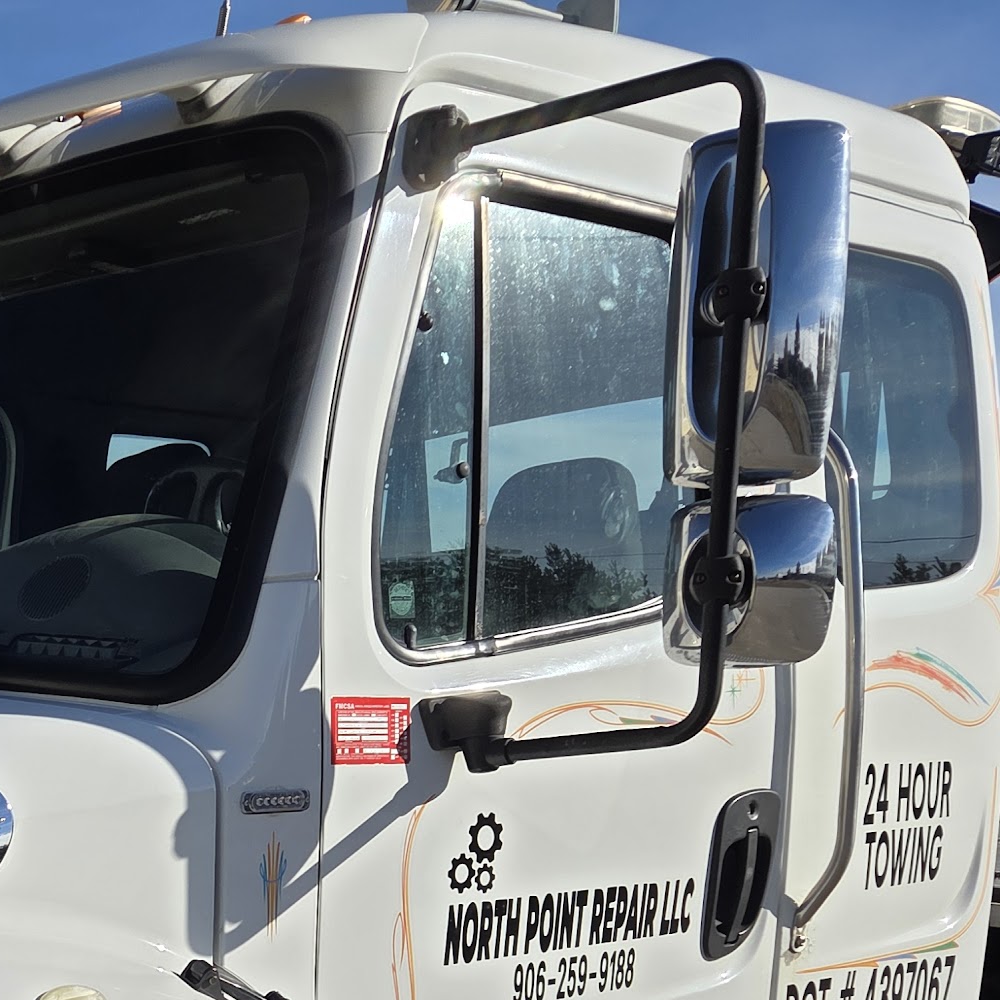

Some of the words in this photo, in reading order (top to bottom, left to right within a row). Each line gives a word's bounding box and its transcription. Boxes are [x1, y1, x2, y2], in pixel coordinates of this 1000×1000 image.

[863, 763, 889, 825] 24
[897, 761, 952, 822] HOUR
[865, 825, 943, 890] TOWING
[443, 897, 522, 966] NORTH
[524, 889, 589, 954] POINT
[588, 883, 658, 946] REPAIR
[659, 878, 695, 936] LLC
